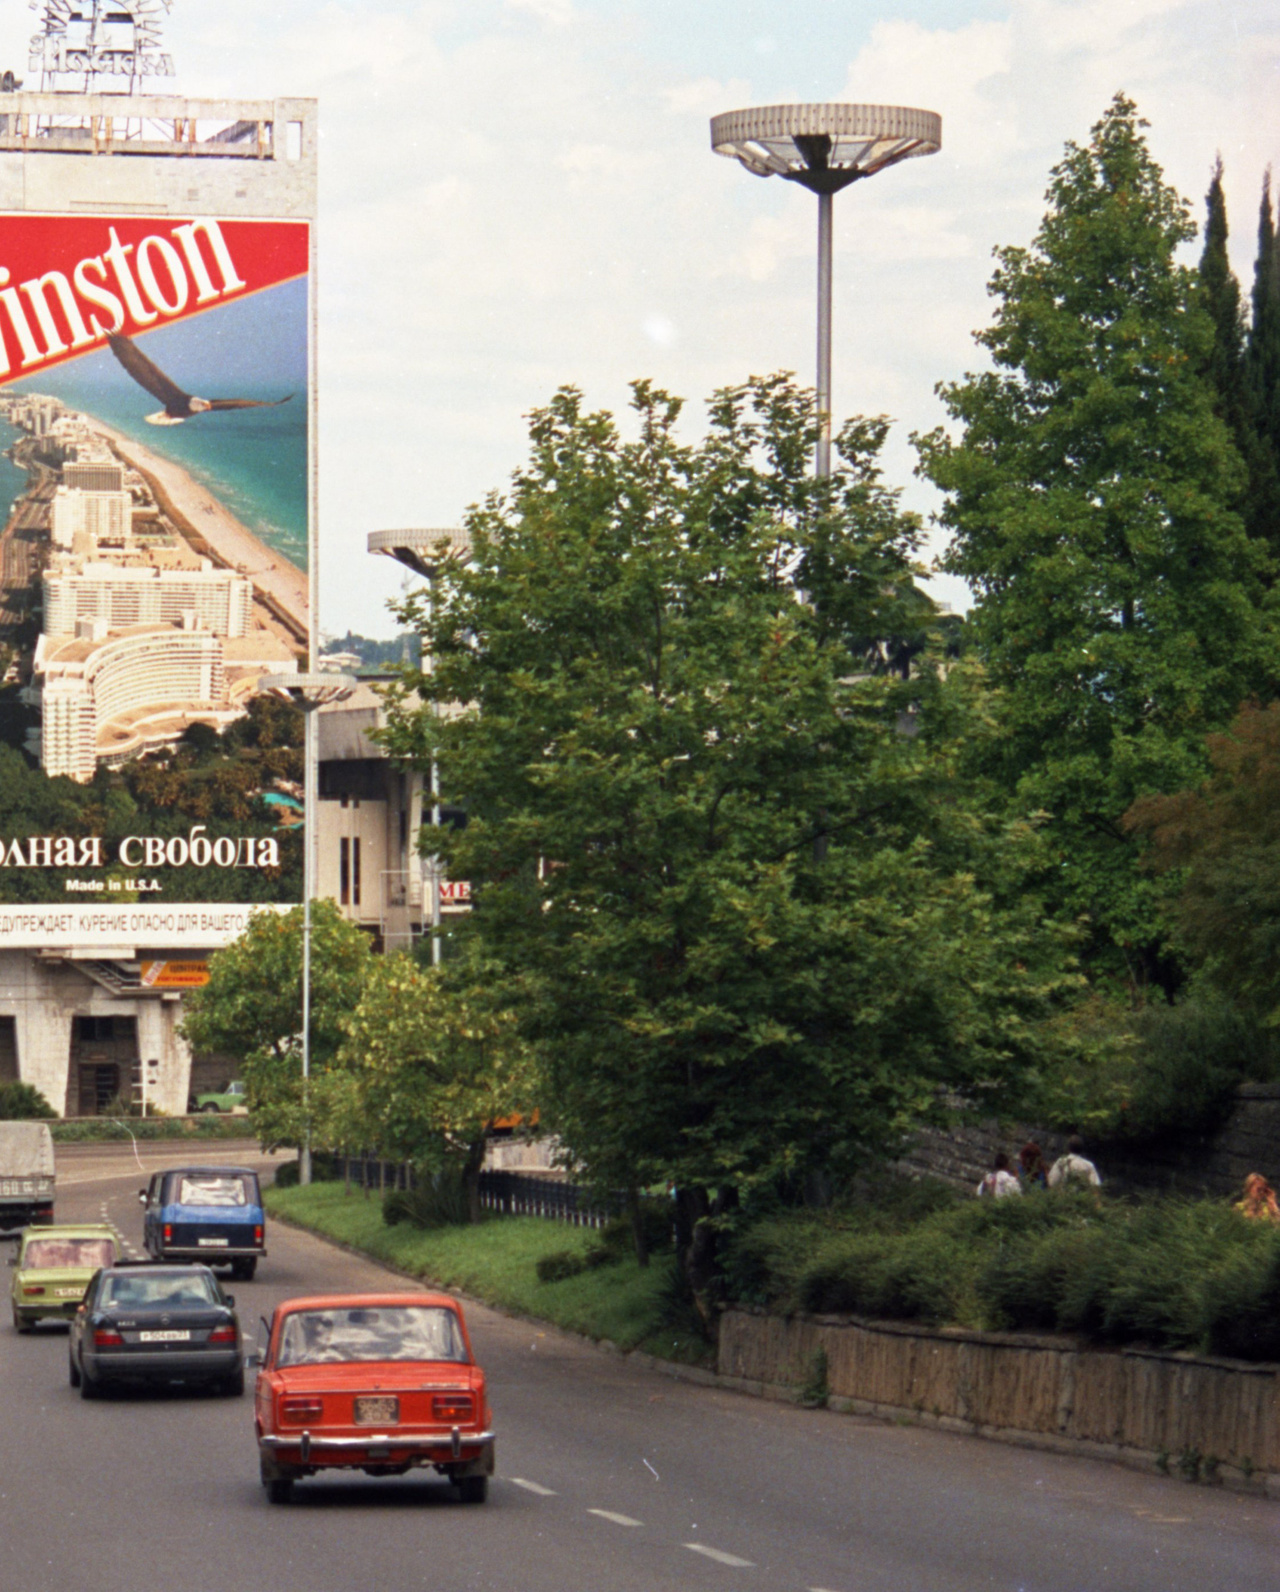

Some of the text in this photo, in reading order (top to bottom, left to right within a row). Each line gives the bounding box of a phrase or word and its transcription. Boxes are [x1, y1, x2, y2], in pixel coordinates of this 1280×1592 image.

[119, 825, 280, 869] свобода
[65, 879, 163, 892] Made in U.S.A.
[79, 914, 127, 932] КУРЕНИЕ
[131, 914, 174, 931] ОПАСНО
[177, 914, 198, 934] ДЛЯ
[201, 914, 244, 931] ВАШЕГО
